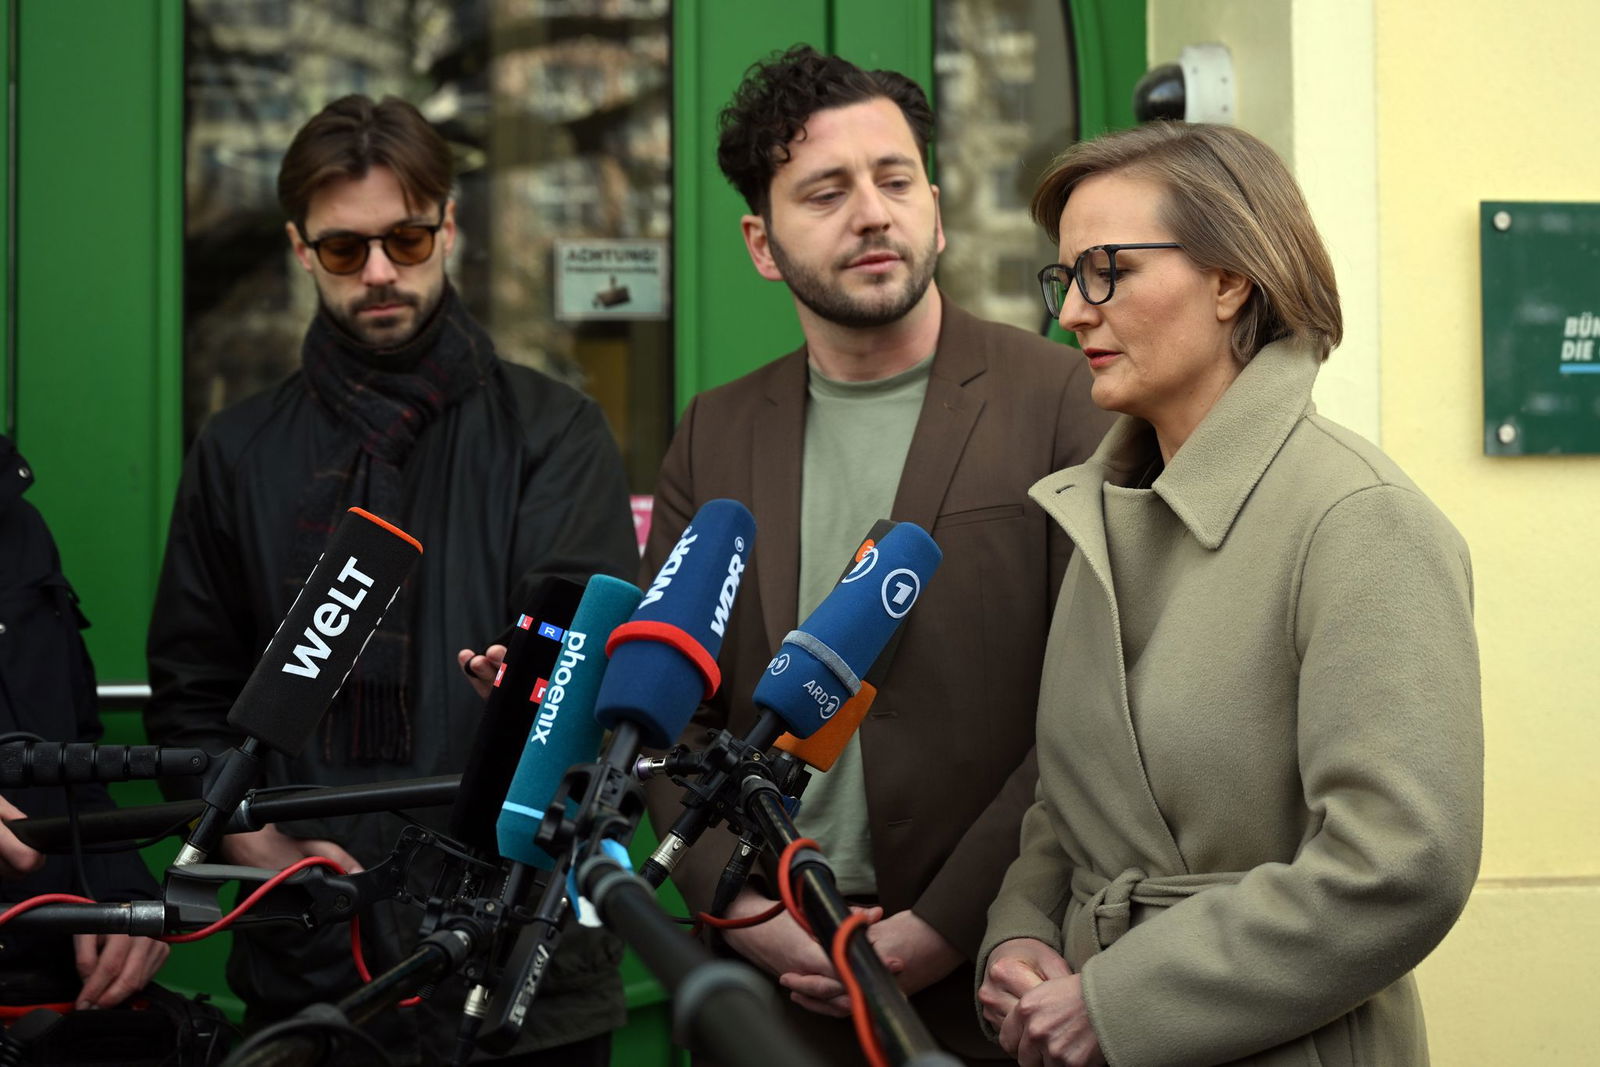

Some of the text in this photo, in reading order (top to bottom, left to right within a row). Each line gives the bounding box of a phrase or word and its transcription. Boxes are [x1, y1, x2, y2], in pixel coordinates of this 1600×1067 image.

[1561, 340, 1594, 361] DIE
[638, 534, 698, 609] WDR
[710, 553, 745, 637] WDR
[531, 630, 587, 745] phoenix
